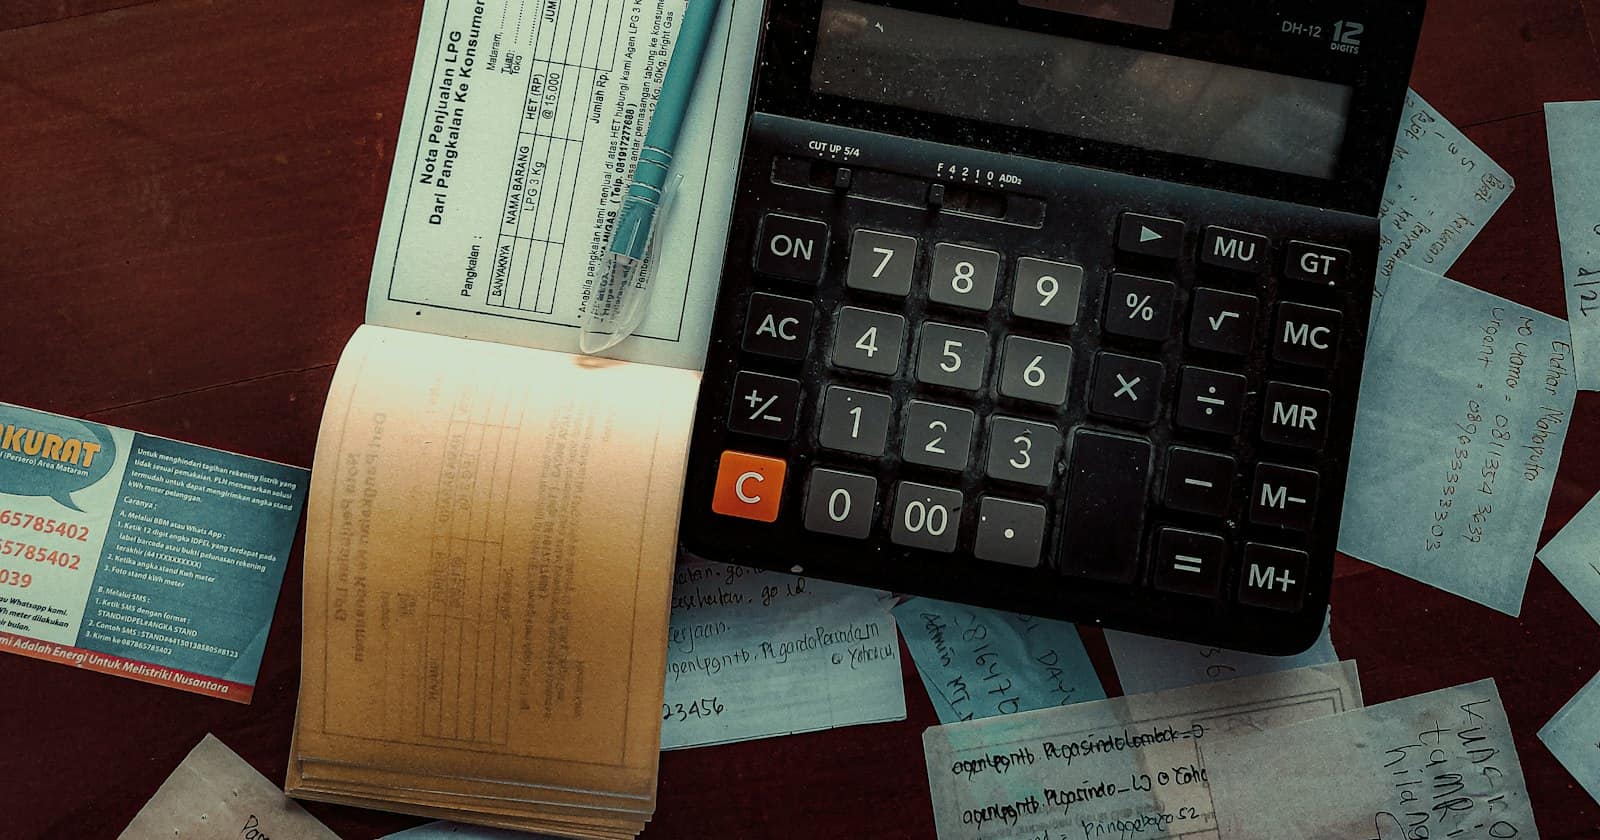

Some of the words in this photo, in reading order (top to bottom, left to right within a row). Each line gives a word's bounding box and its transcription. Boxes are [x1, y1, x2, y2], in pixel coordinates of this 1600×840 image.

[628, 14, 640, 34] LPG
[663, 10, 674, 28] Gas
[1281, 20, 1322, 38] DH-12
[1332, 20, 1364, 46] 12
[444, 30, 461, 63] LPG
[624, 35, 636, 59] Agen
[647, 36, 658, 47] ke
[657, 30, 671, 56] Bright
[1330, 42, 1359, 55] DIGITS
[595, 70, 610, 87] Rp.
[643, 49, 658, 79] tabung
[453, 82, 469, 102] Ke
[530, 73, 545, 96] (RP)
[544, 72, 560, 105] 15.000
[613, 82, 629, 117] hubungi
[428, 67, 454, 143] Penjualan
[525, 97, 538, 120] HET
[541, 108, 554, 119] @
[590, 89, 604, 124] Jumlah
[634, 81, 652, 137] pemasangan
[609, 118, 621, 138] HET
[436, 107, 463, 188] Pangkalan
[607, 140, 618, 159] atas
[808, 140, 828, 152] CUT
[829, 143, 842, 154] UP
[844, 146, 860, 158] 5/4
[419, 148, 438, 184] Nota
[512, 145, 530, 191] BARANG
[531, 160, 546, 176] Kg
[937, 162, 945, 172] F
[949, 164, 957, 174] 4
[962, 167, 969, 177] 2
[987, 171, 994, 181] 0
[428, 192, 446, 225] Dari
[505, 192, 520, 224] NAMA
[523, 187, 538, 211] LPG
[586, 230, 601, 277] pangkalan
[770, 234, 814, 261] ON
[1213, 236, 1256, 262] MU
[460, 244, 480, 297] Pangkalan
[491, 244, 510, 296] BANYAKNYA
[872, 247, 894, 279] 7
[951, 261, 976, 294] 8
[1300, 252, 1336, 276] GT
[1036, 275, 1059, 307] 9
[756, 313, 800, 342] AC
[855, 326, 879, 359] 4
[1283, 320, 1331, 351] MC
[939, 340, 963, 373] 5
[1023, 355, 1046, 388] 6
[848, 406, 862, 439] 1
[1272, 401, 1319, 431] MR
[0, 423, 102, 469] KURAT
[137, 447, 158, 458] Untuk
[925, 421, 947, 455] 2
[1009, 435, 1033, 470] 3
[3, 451, 37, 466] (Persero)
[37, 459, 55, 470] Area
[56, 463, 89, 477] Mataram
[123, 495, 153, 508] Caranya
[735, 471, 765, 505] C
[828, 488, 852, 522] 0
[904, 500, 948, 536] 00
[0, 540, 81, 570] 5785402
[1248, 563, 1296, 593] M+
[9, 597, 47, 613] Whatsapp
[9, 610, 32, 619] meter
[31, 614, 70, 629] dilakukan
[13, 639, 52, 656] Adalah
[51, 646, 88, 663] Energi
[88, 654, 121, 669] Untuk
[121, 661, 173, 680] Melistriki
[172, 672, 228, 693] Nusantara
